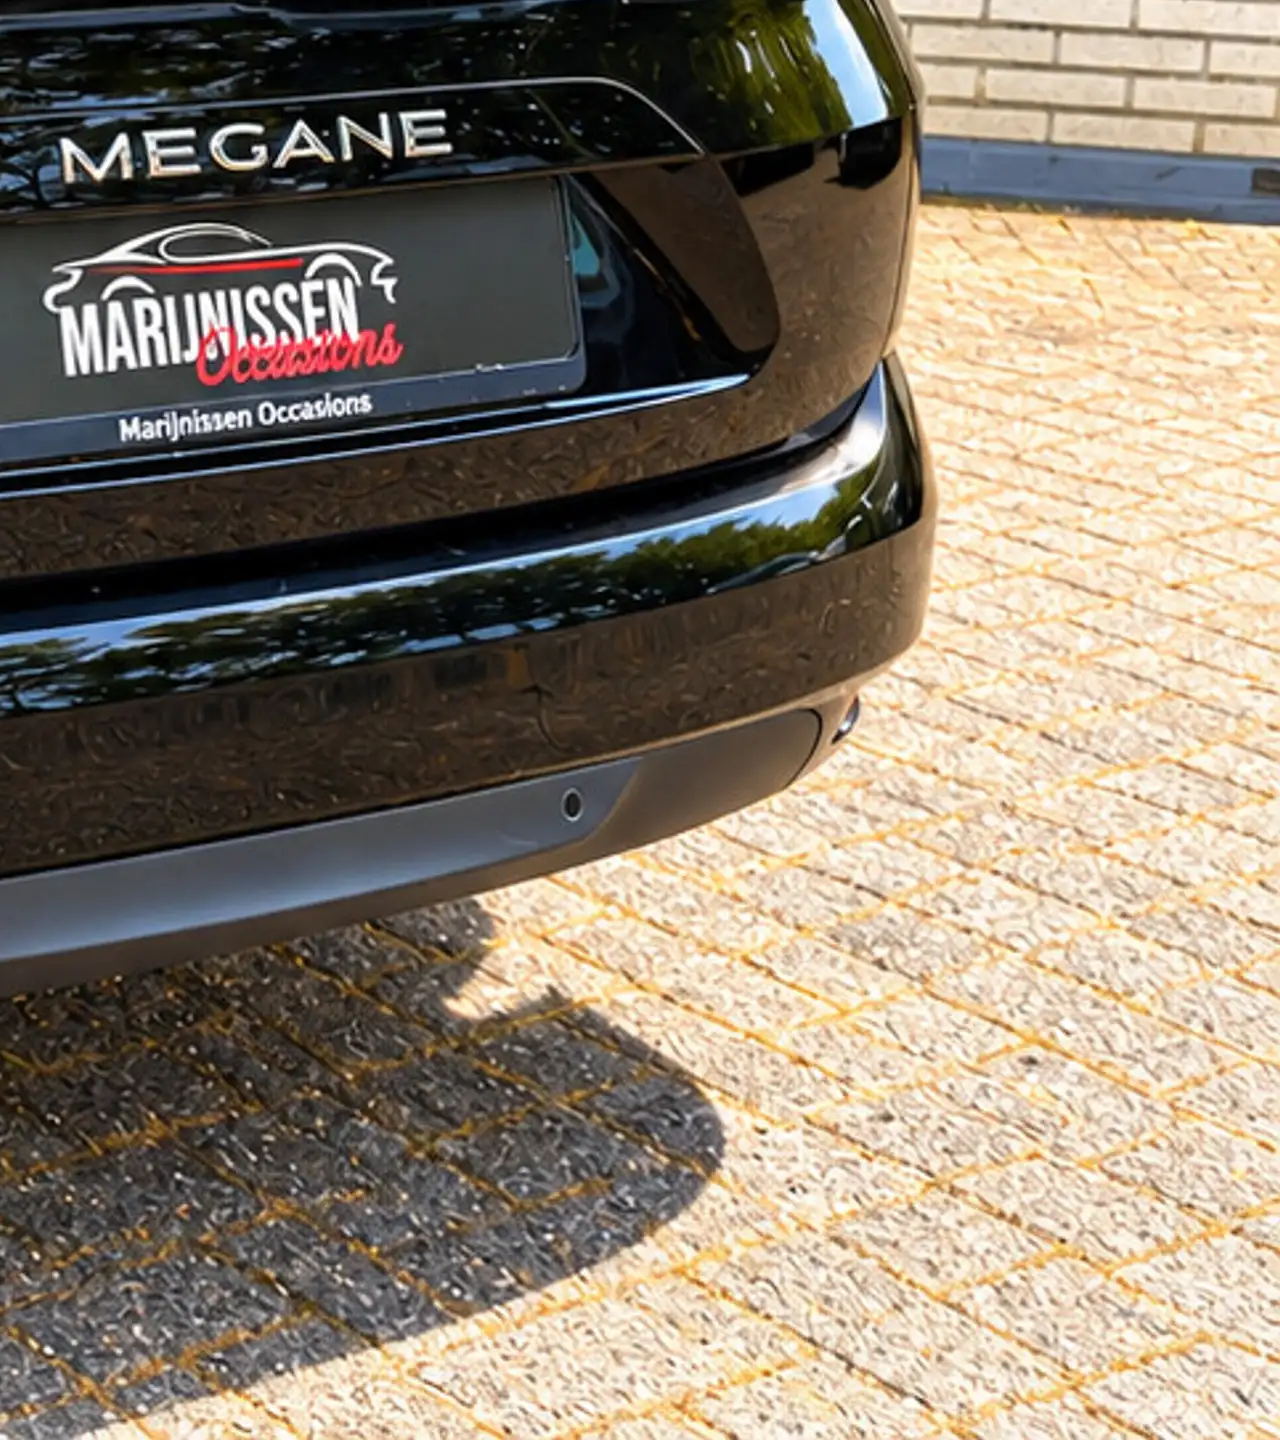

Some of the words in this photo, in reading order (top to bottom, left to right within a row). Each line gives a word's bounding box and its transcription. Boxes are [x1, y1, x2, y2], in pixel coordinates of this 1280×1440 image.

[59, 109, 453, 183] MEGANE
[59, 275, 358, 377] MARIJNISSEN
[195, 322, 405, 387] Occasions
[118, 408, 253, 442] Marijnissen
[258, 392, 373, 426] Occasions
